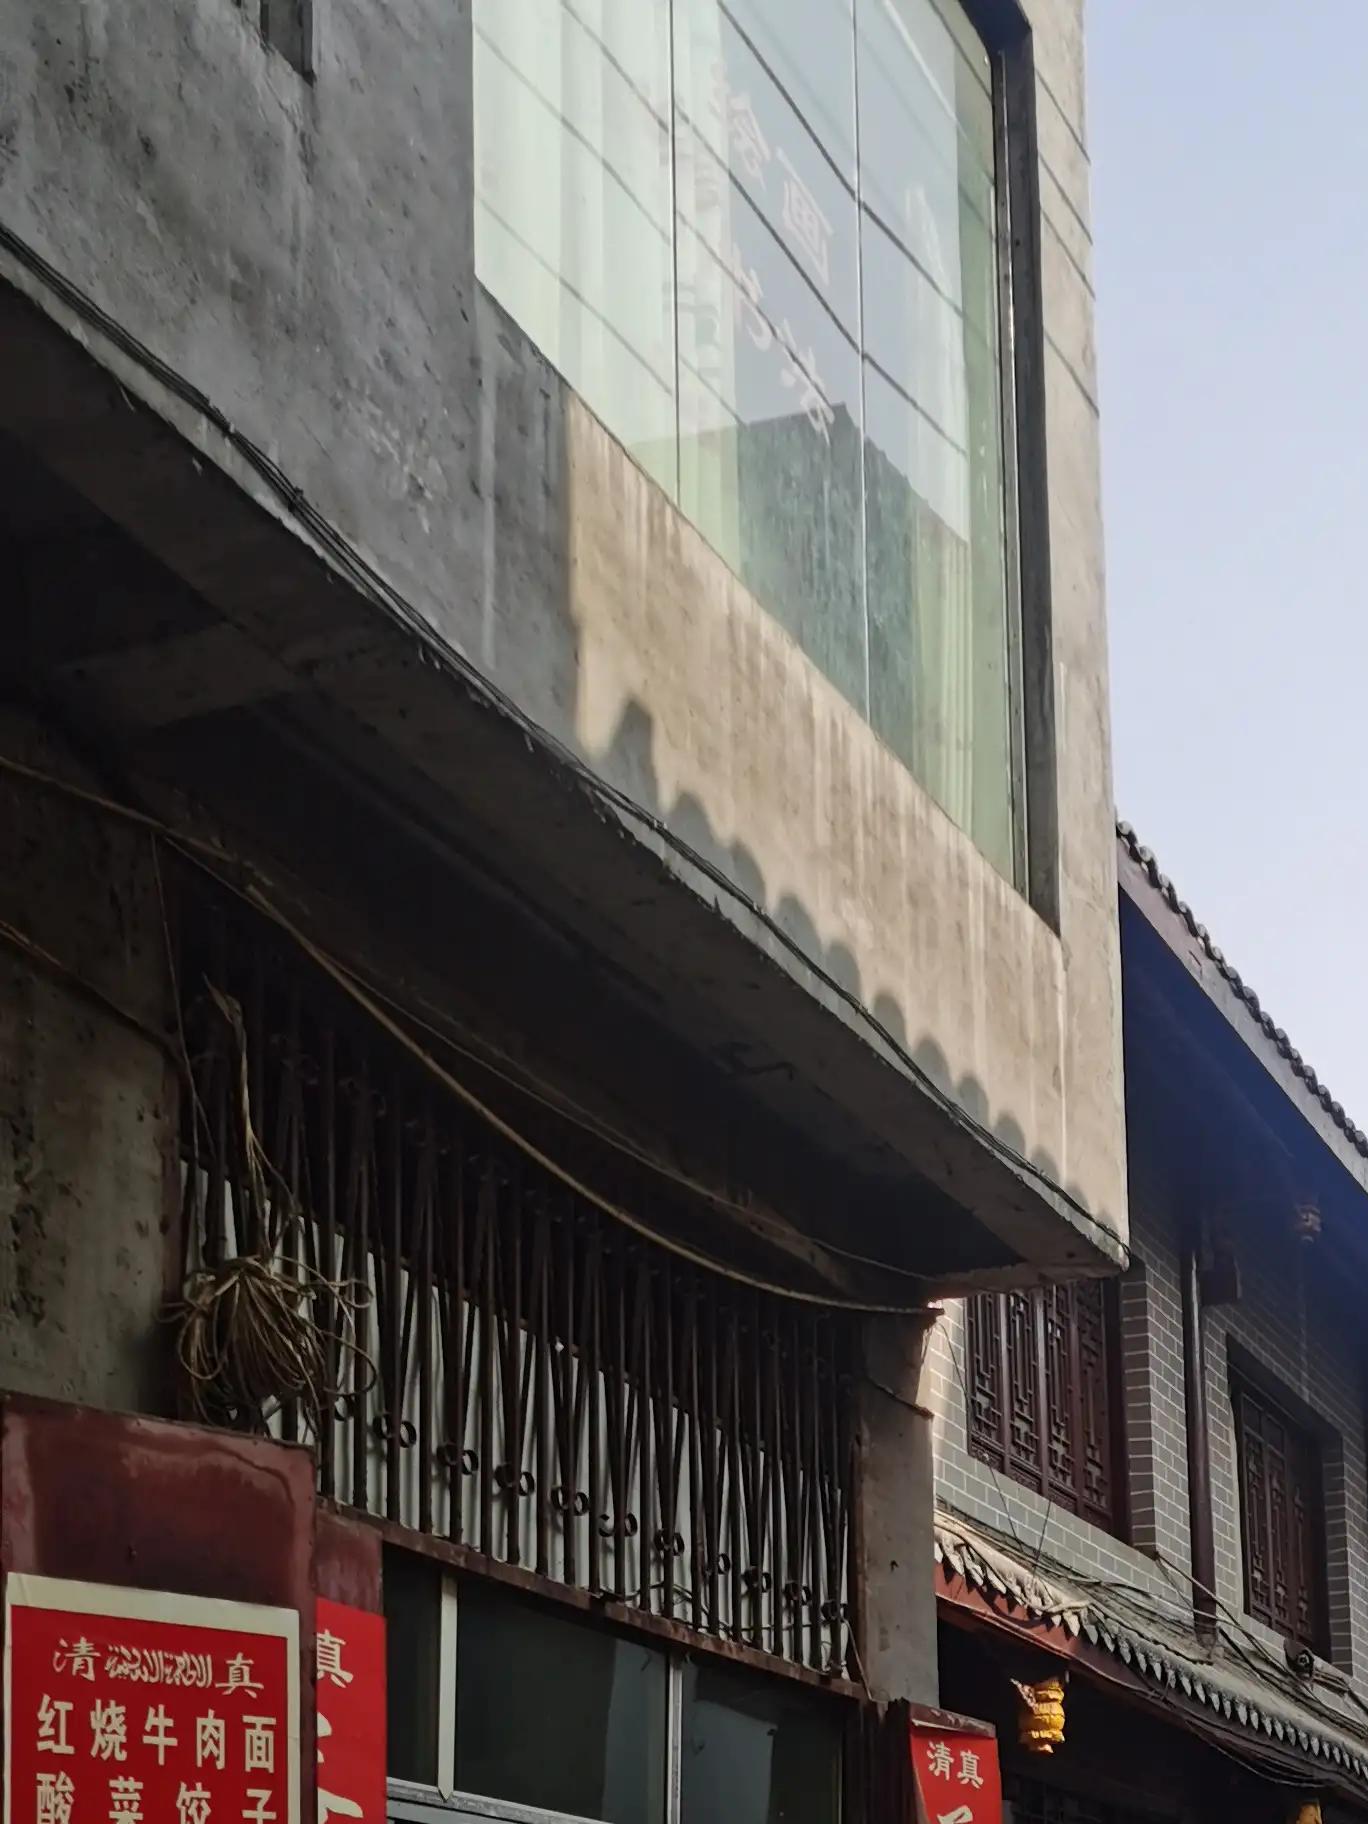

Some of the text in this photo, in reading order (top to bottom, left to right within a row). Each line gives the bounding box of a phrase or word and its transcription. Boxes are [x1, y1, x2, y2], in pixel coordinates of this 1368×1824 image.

[53, 1636, 102, 1682] 清
[215, 1652, 265, 1698] 真
[317, 1629, 354, 1688] 真
[36, 1693, 277, 1774] 红烧牛肉面
[926, 1741, 984, 1789] 清真
